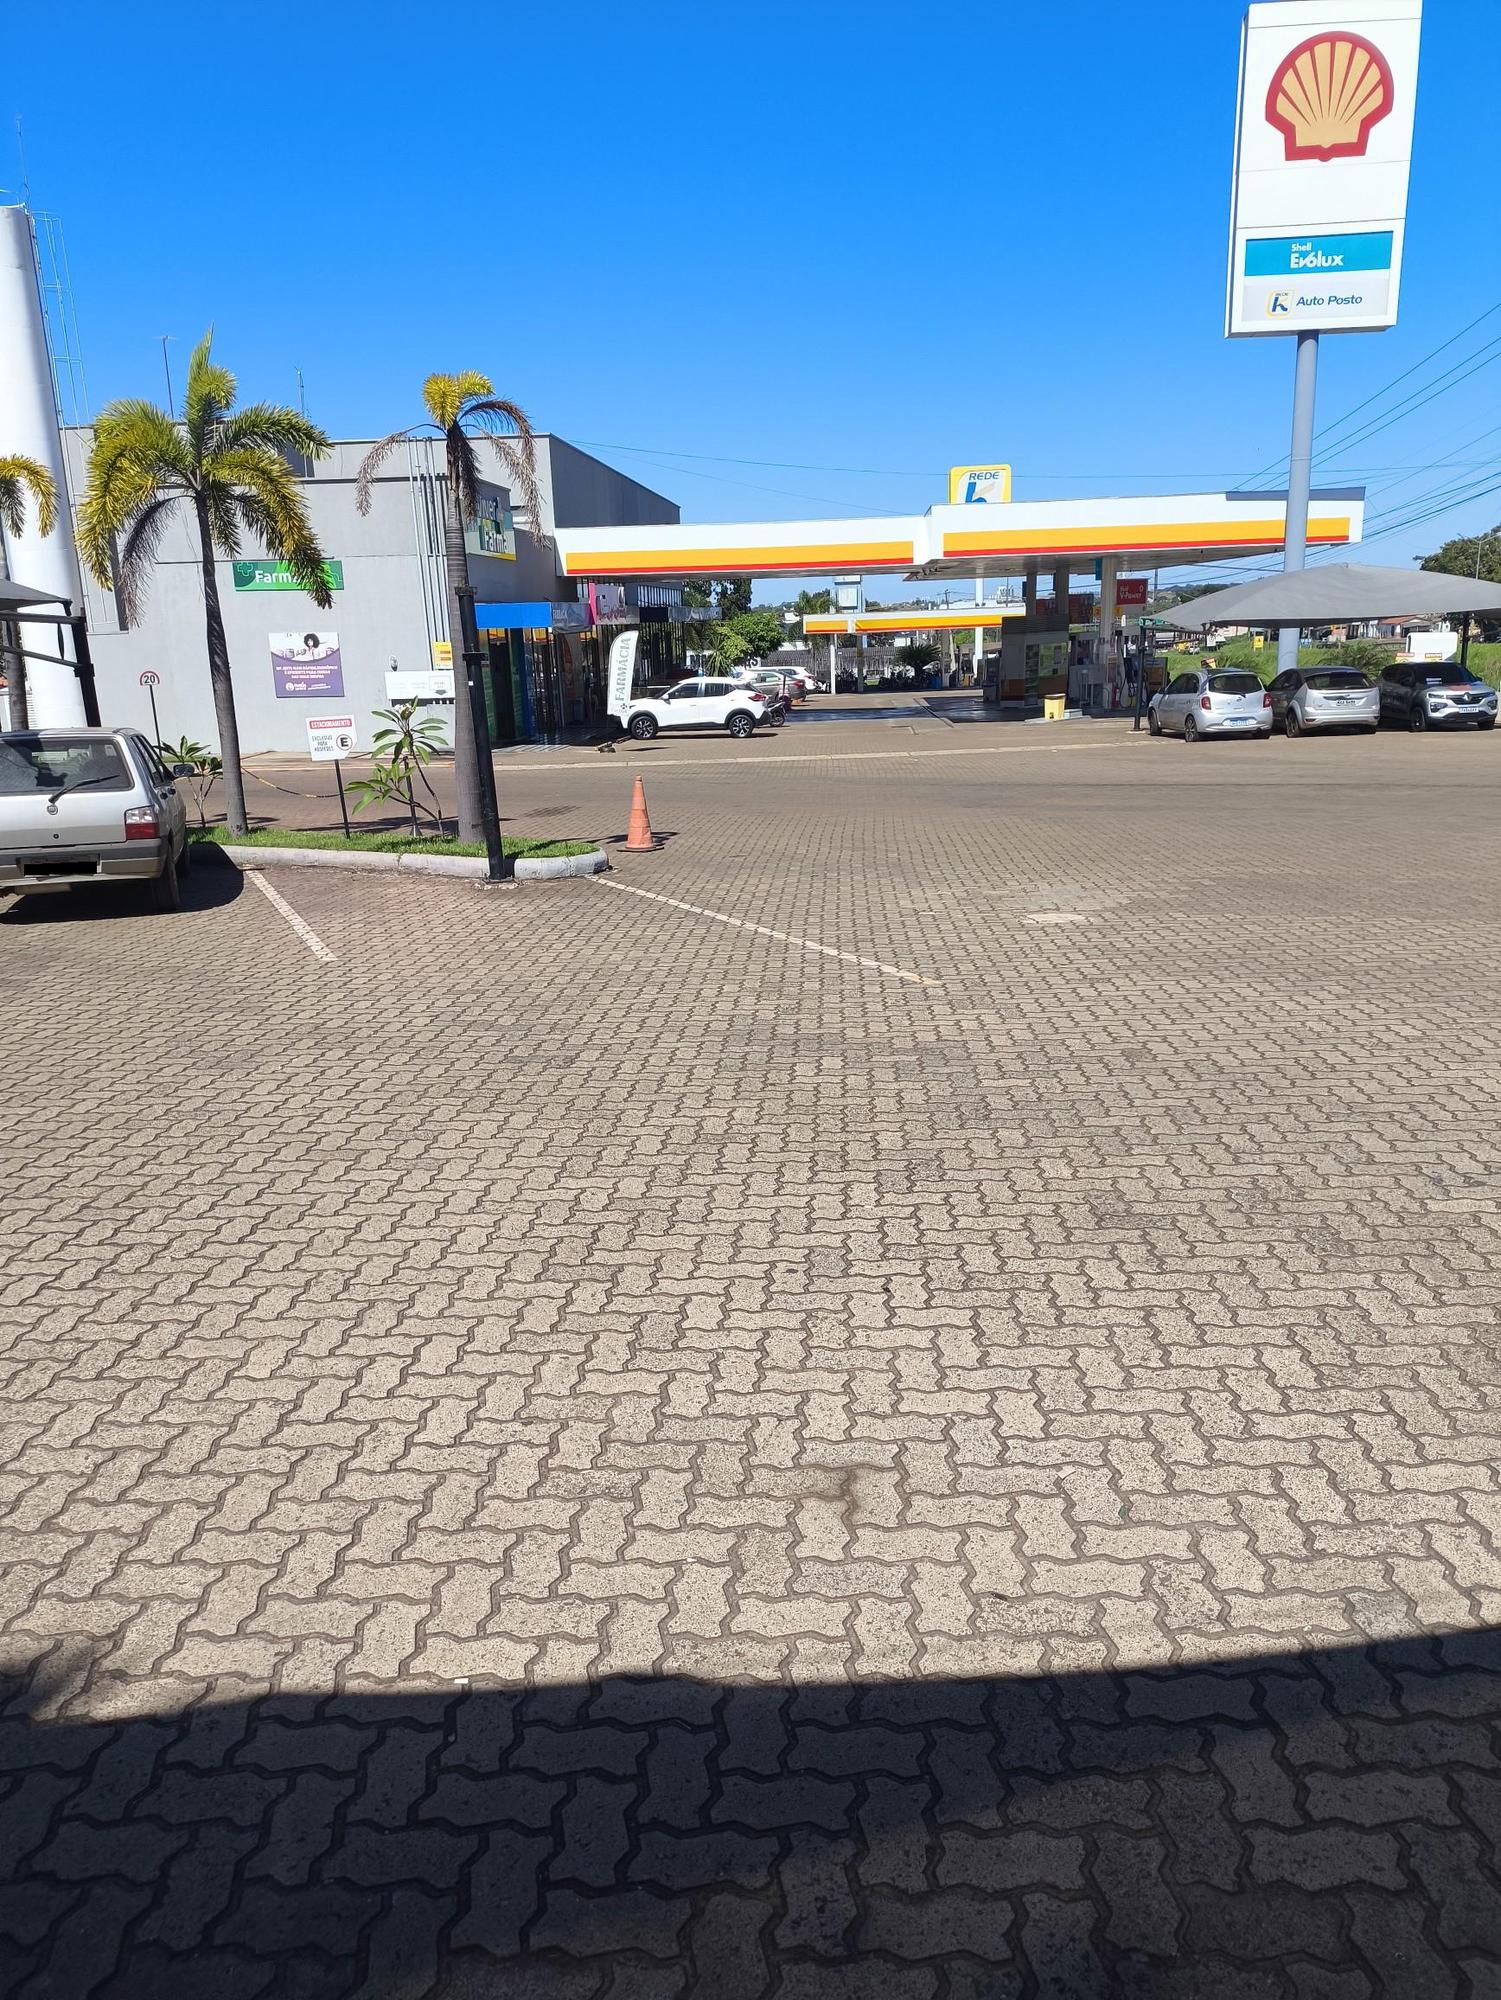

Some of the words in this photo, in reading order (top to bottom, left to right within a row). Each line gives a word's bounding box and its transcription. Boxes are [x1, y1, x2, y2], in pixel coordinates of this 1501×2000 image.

[1291, 242, 1312, 252] Shell
[1296, 296, 1325, 307] Auto
[1327, 294, 1363, 306] Posto
[969, 471, 1000, 481] REDE
[615, 637, 632, 702] FARMÁCIA
[144, 675, 156, 684] 20
[310, 720, 352, 728] ESTACIONAMENTO
[340, 737, 350, 748] E
